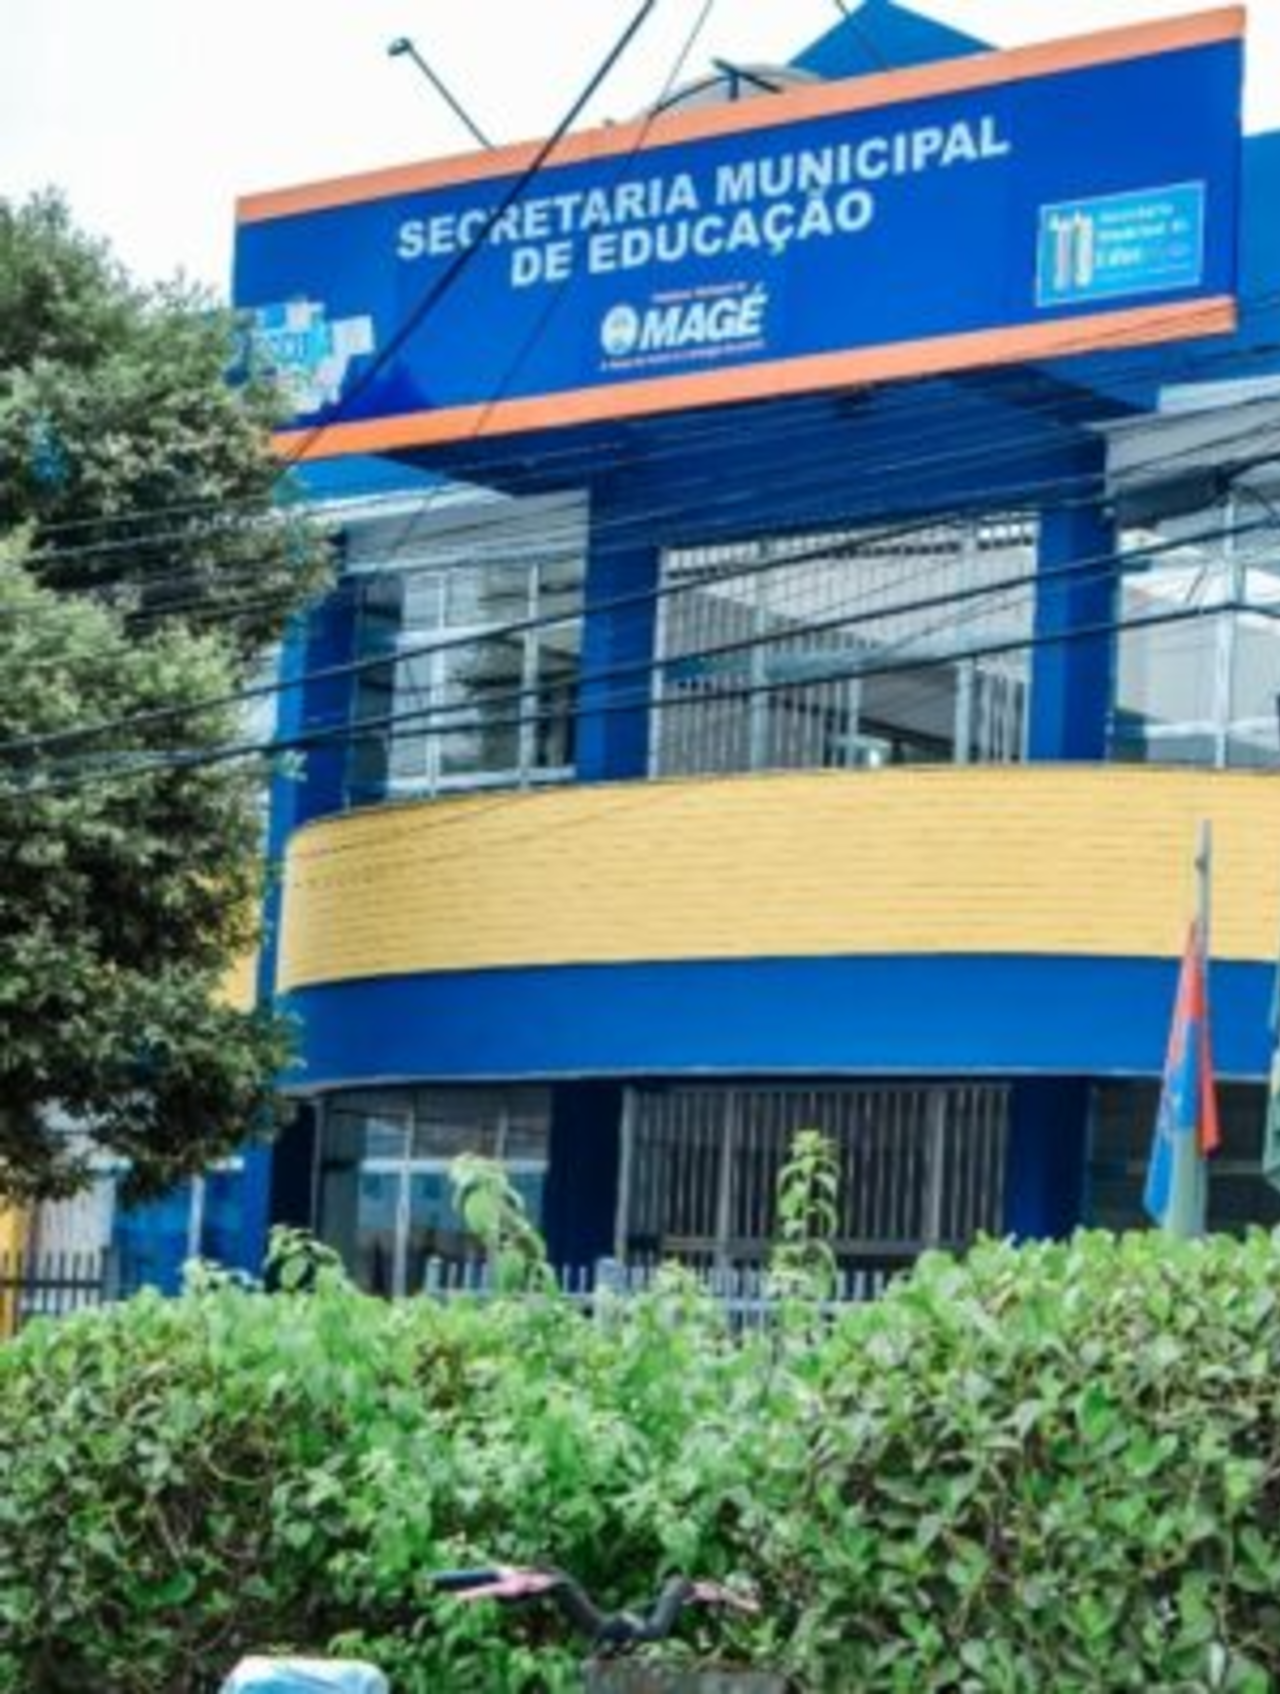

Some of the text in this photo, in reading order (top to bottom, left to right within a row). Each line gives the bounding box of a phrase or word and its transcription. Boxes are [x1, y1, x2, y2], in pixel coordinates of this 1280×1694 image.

[397, 116, 1010, 259] SECRETARIA MUNICIPAL
[511, 190, 873, 287] DE EDUCAÇÃO
[640, 281, 767, 351] MAGÉ
